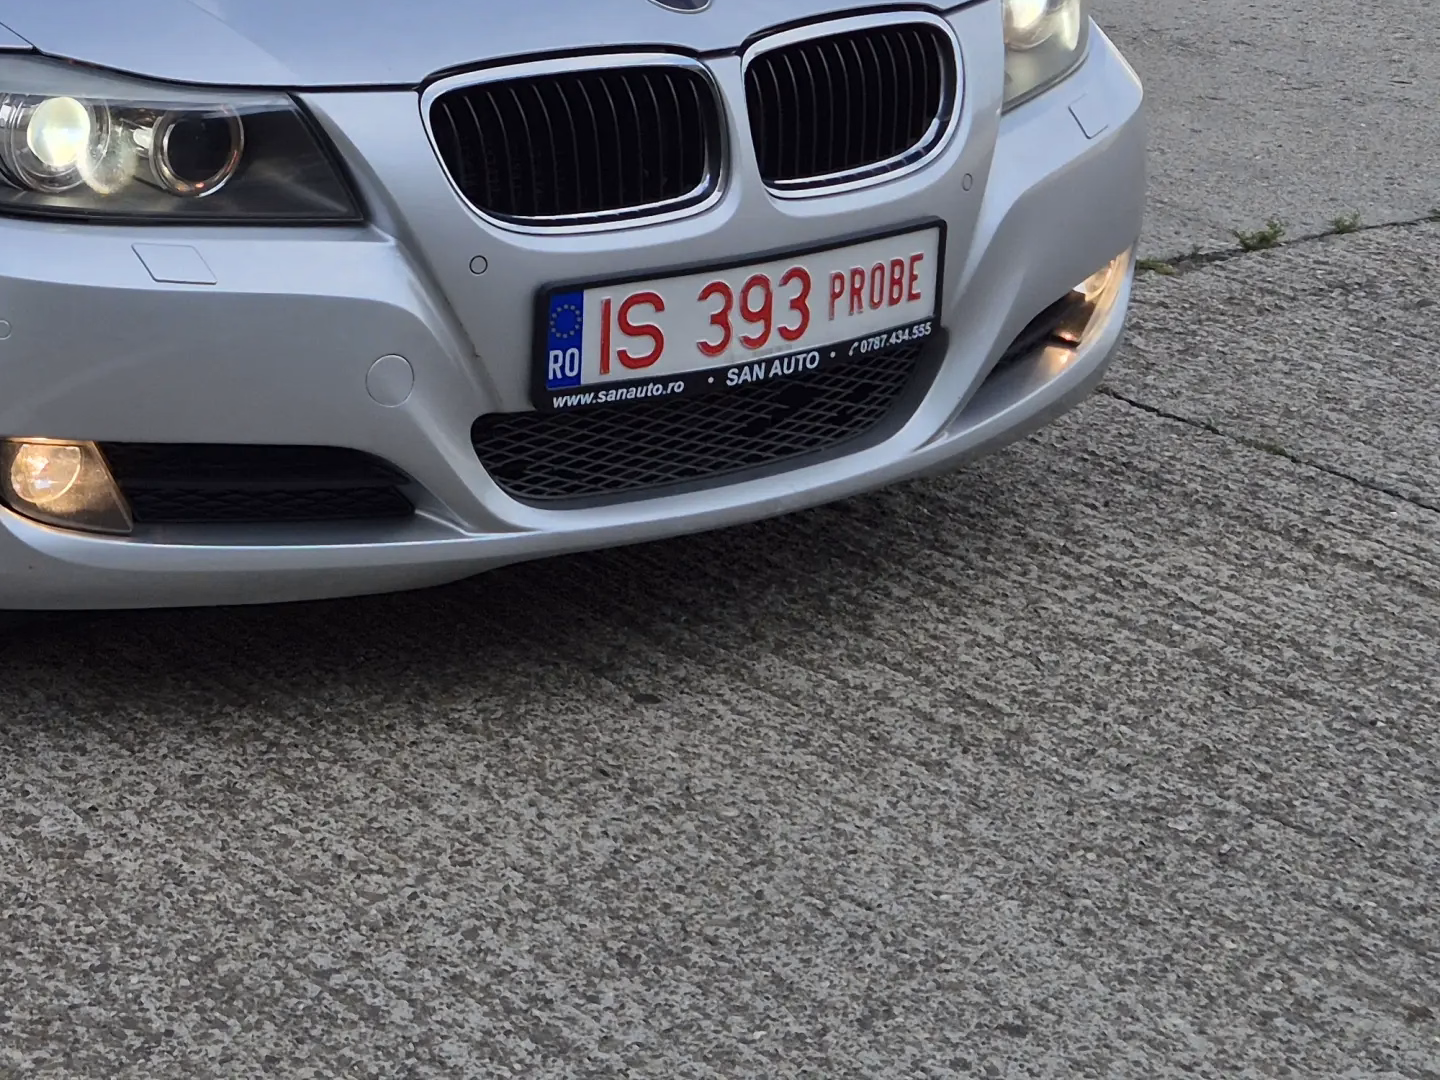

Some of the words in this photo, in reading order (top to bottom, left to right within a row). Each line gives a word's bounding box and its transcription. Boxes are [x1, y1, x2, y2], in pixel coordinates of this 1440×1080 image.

[598, 291, 666, 376] IS
[696, 266, 813, 357] 393
[828, 252, 925, 321] PROBE
[548, 347, 580, 381] RO
[552, 380, 685, 409] www.sanauto.ro
[726, 357, 766, 387] SAN
[768, 351, 820, 379] AUTO
[859, 322, 933, 354] 0787.434.555
